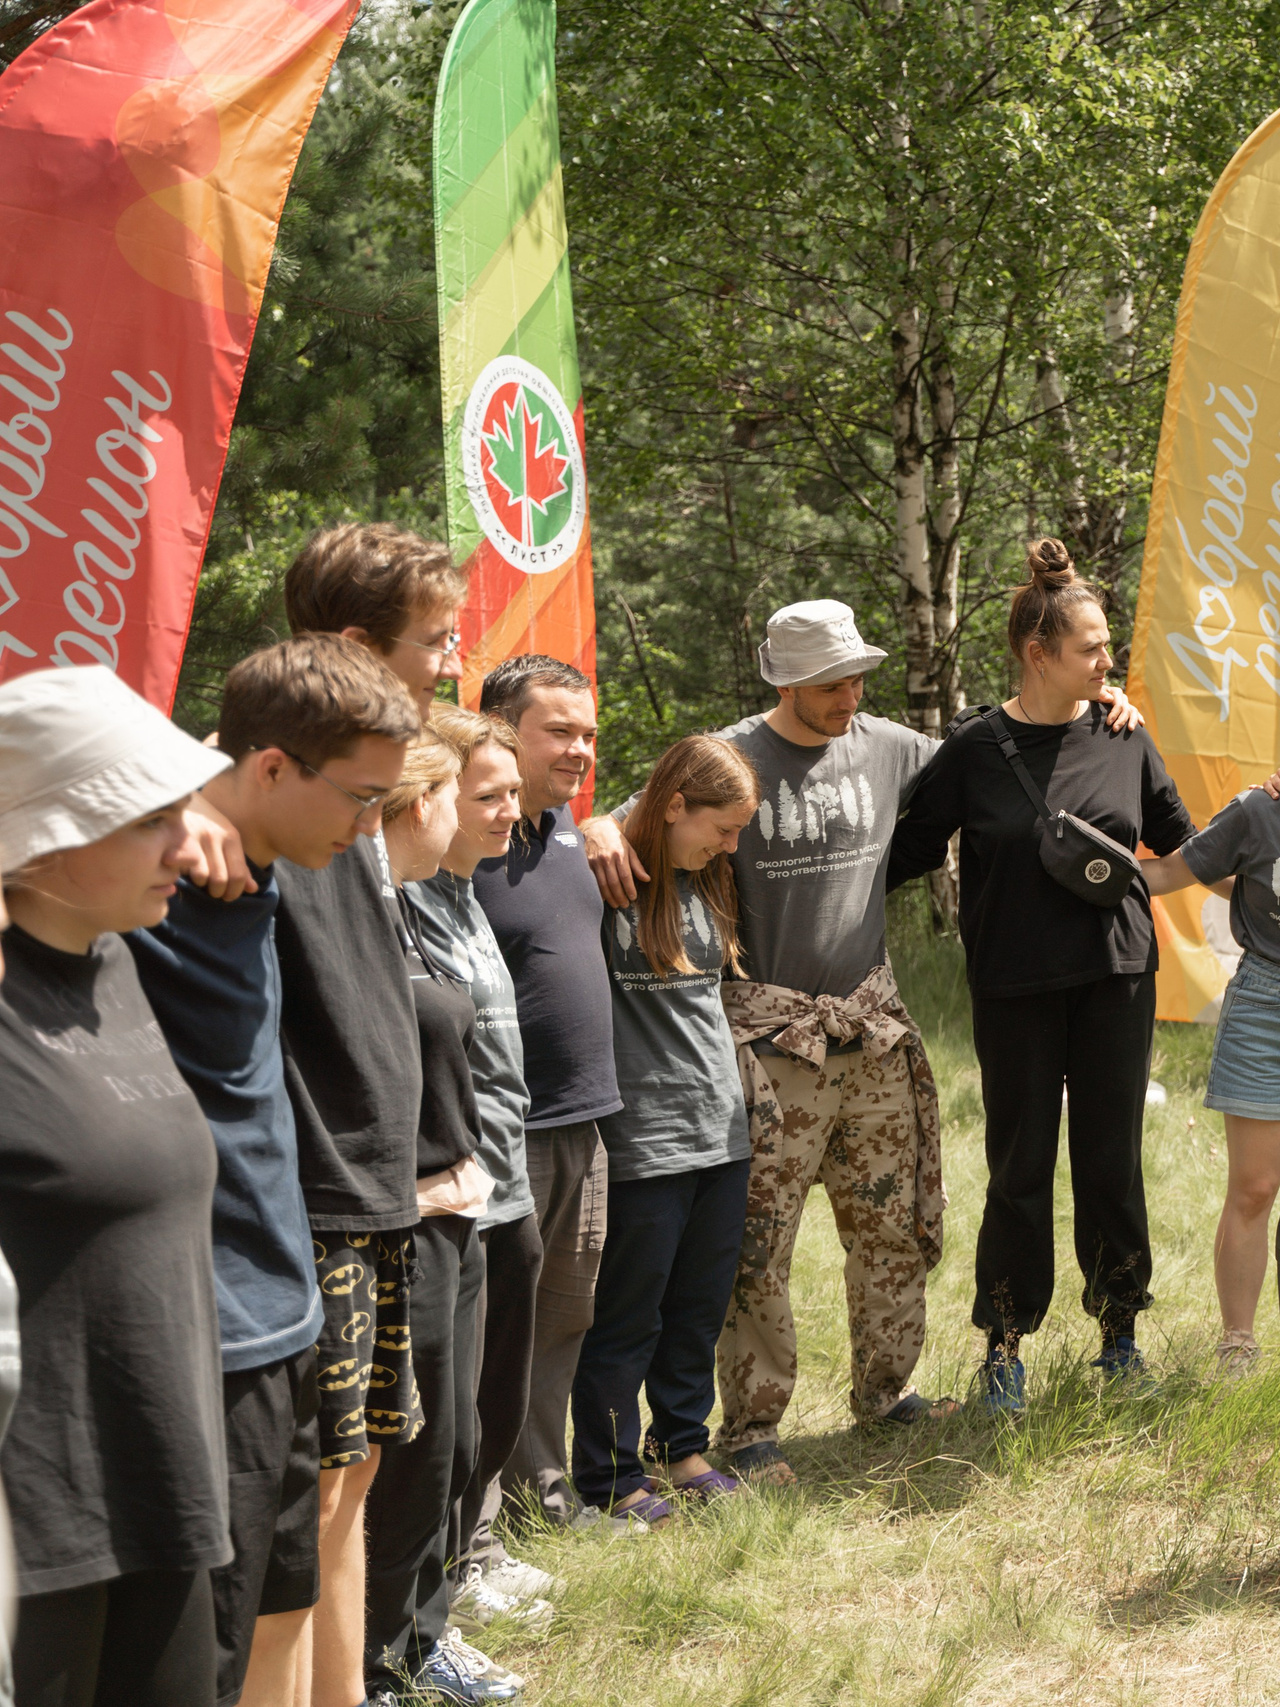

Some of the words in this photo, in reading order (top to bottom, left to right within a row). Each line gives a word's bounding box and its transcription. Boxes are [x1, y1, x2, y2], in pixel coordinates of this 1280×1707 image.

[1166, 382, 1259, 723] Добрый
[755, 855, 812, 870] Экология
[826, 851, 845, 861] это
[846, 849, 858, 858] не
[766, 870, 790, 879] Это
[623, 982, 646, 991] Это
